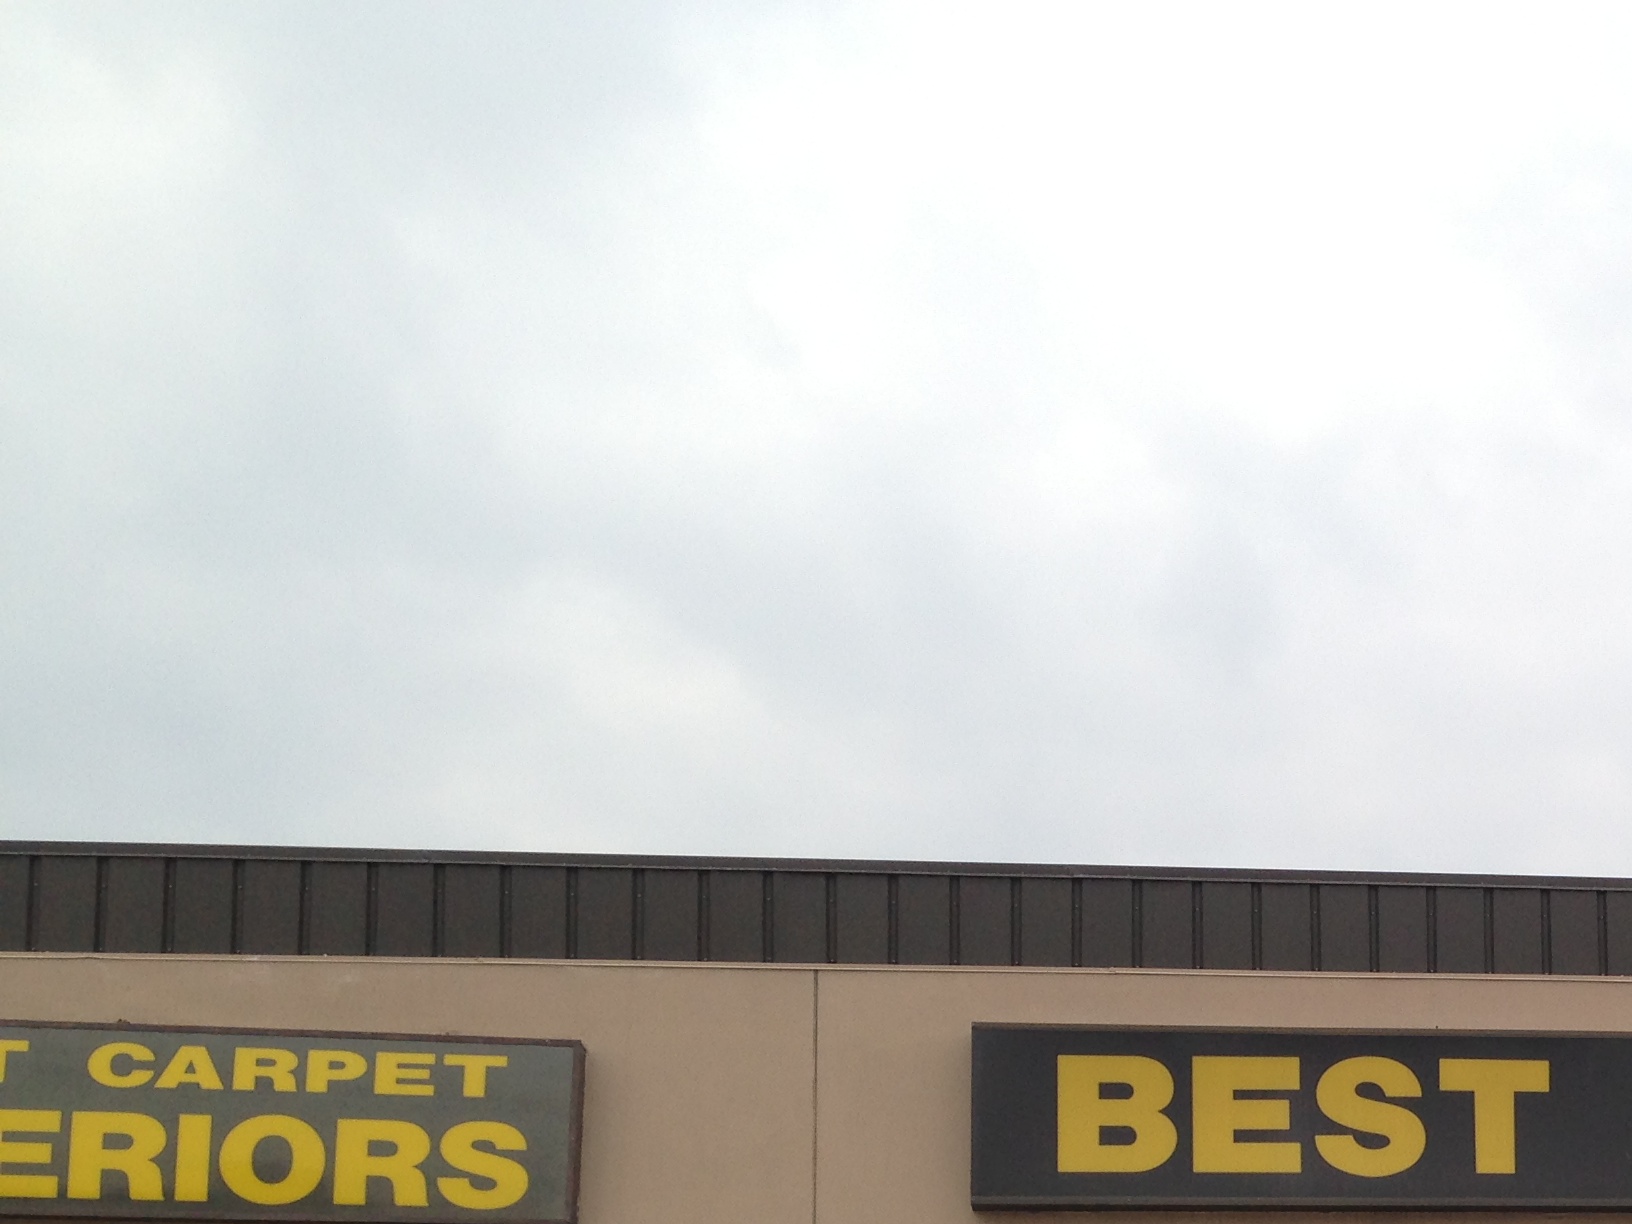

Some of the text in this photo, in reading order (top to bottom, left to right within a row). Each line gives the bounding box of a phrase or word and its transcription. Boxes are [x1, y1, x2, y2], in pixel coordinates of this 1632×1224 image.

[87, 1042, 508, 1098] CARPET
[1057, 1054, 1551, 1178] BEST
[0, 1109, 529, 1210] ERIORS
